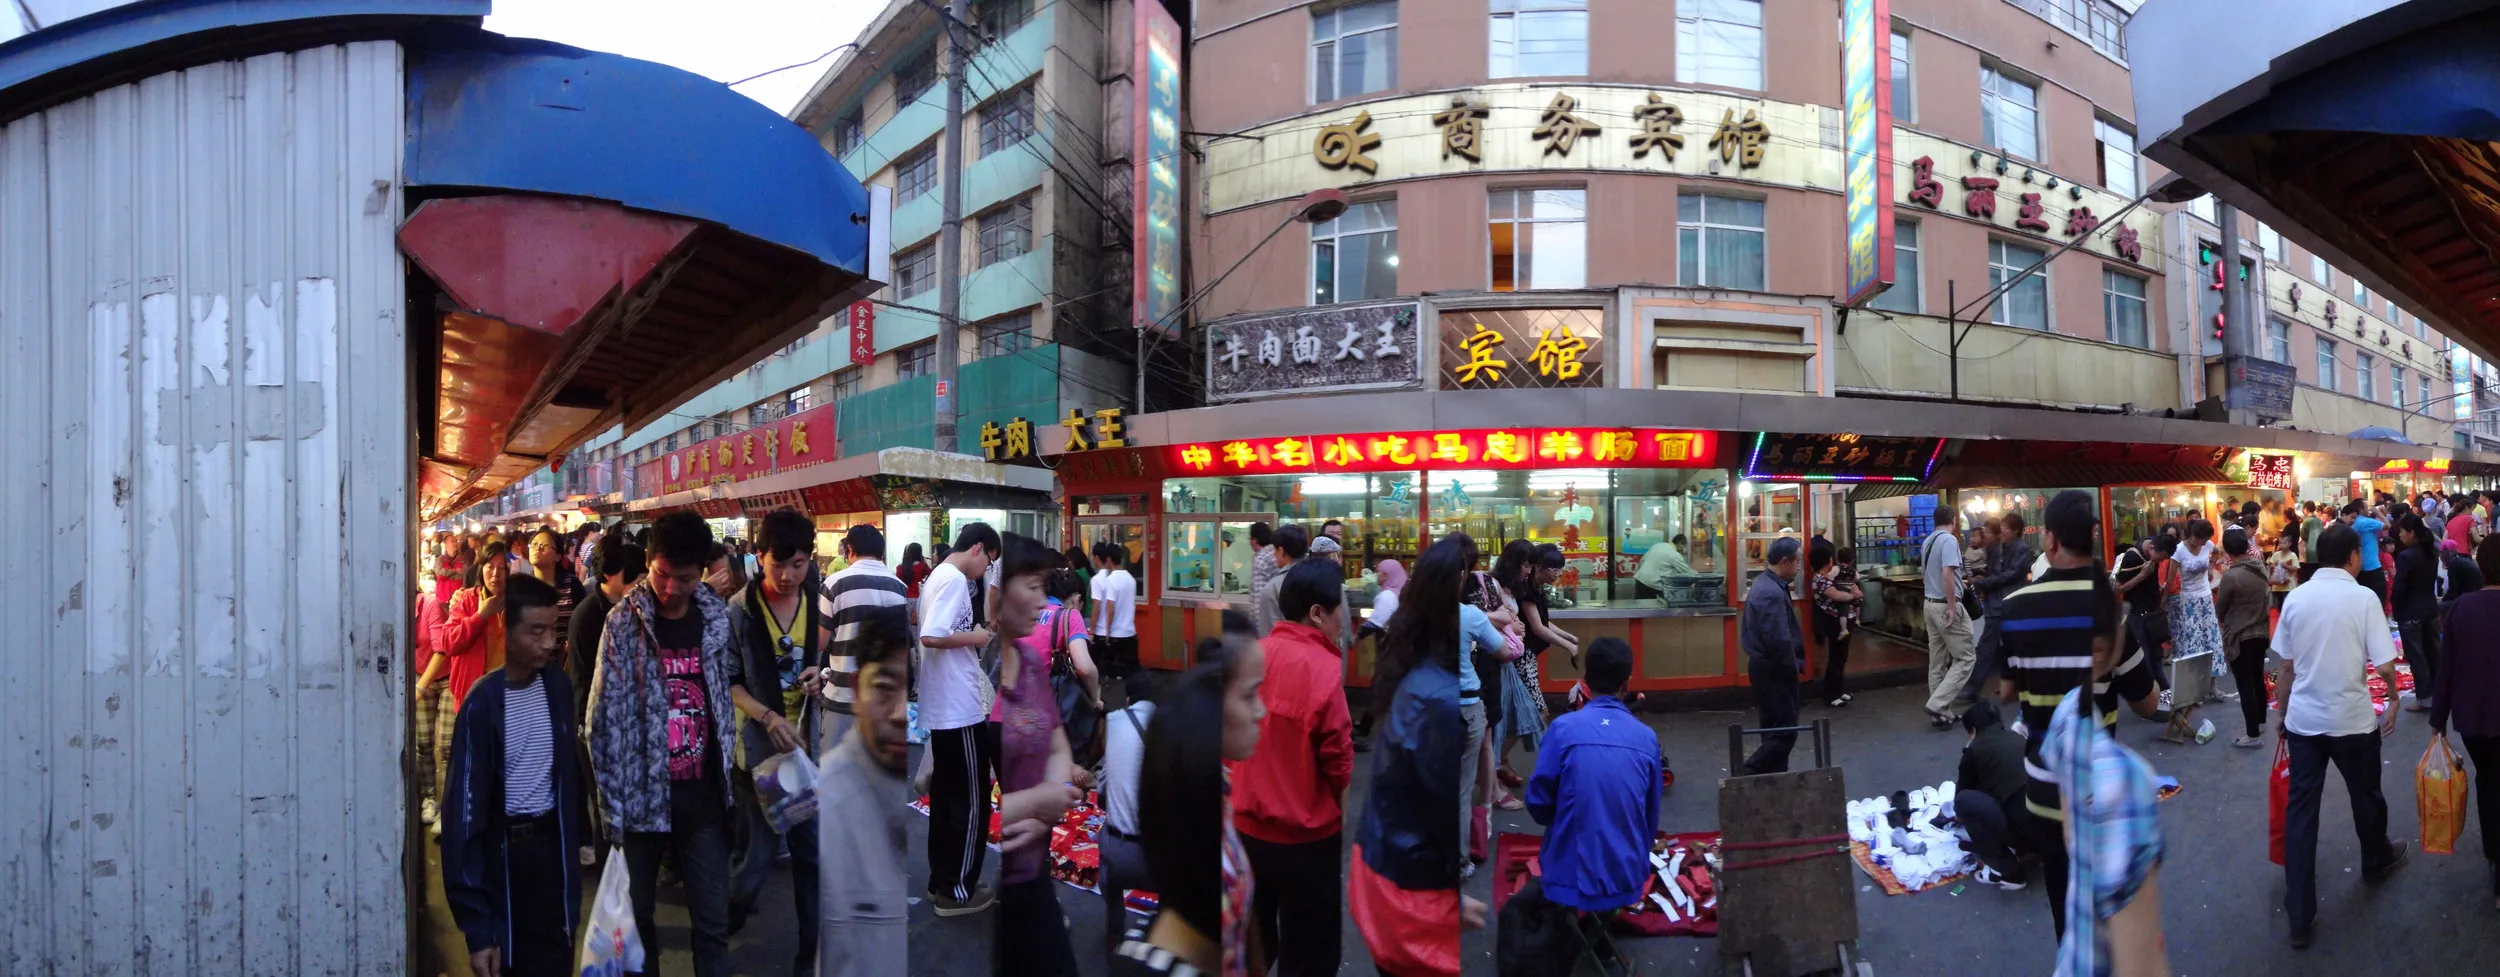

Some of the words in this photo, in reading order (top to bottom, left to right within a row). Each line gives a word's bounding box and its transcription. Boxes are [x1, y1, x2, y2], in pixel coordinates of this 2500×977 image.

[1432, 90, 1771, 168] 商务宾馆
[1219, 320, 1402, 374] 牛肉面大王
[1454, 322, 1588, 383] 宾馆
[980, 416, 1031, 460] 牛肉
[1062, 407, 1126, 451] 大王
[2248, 471, 2291, 489] 阿拉伯烤肉
[2250, 455, 2291, 473] 马忠
